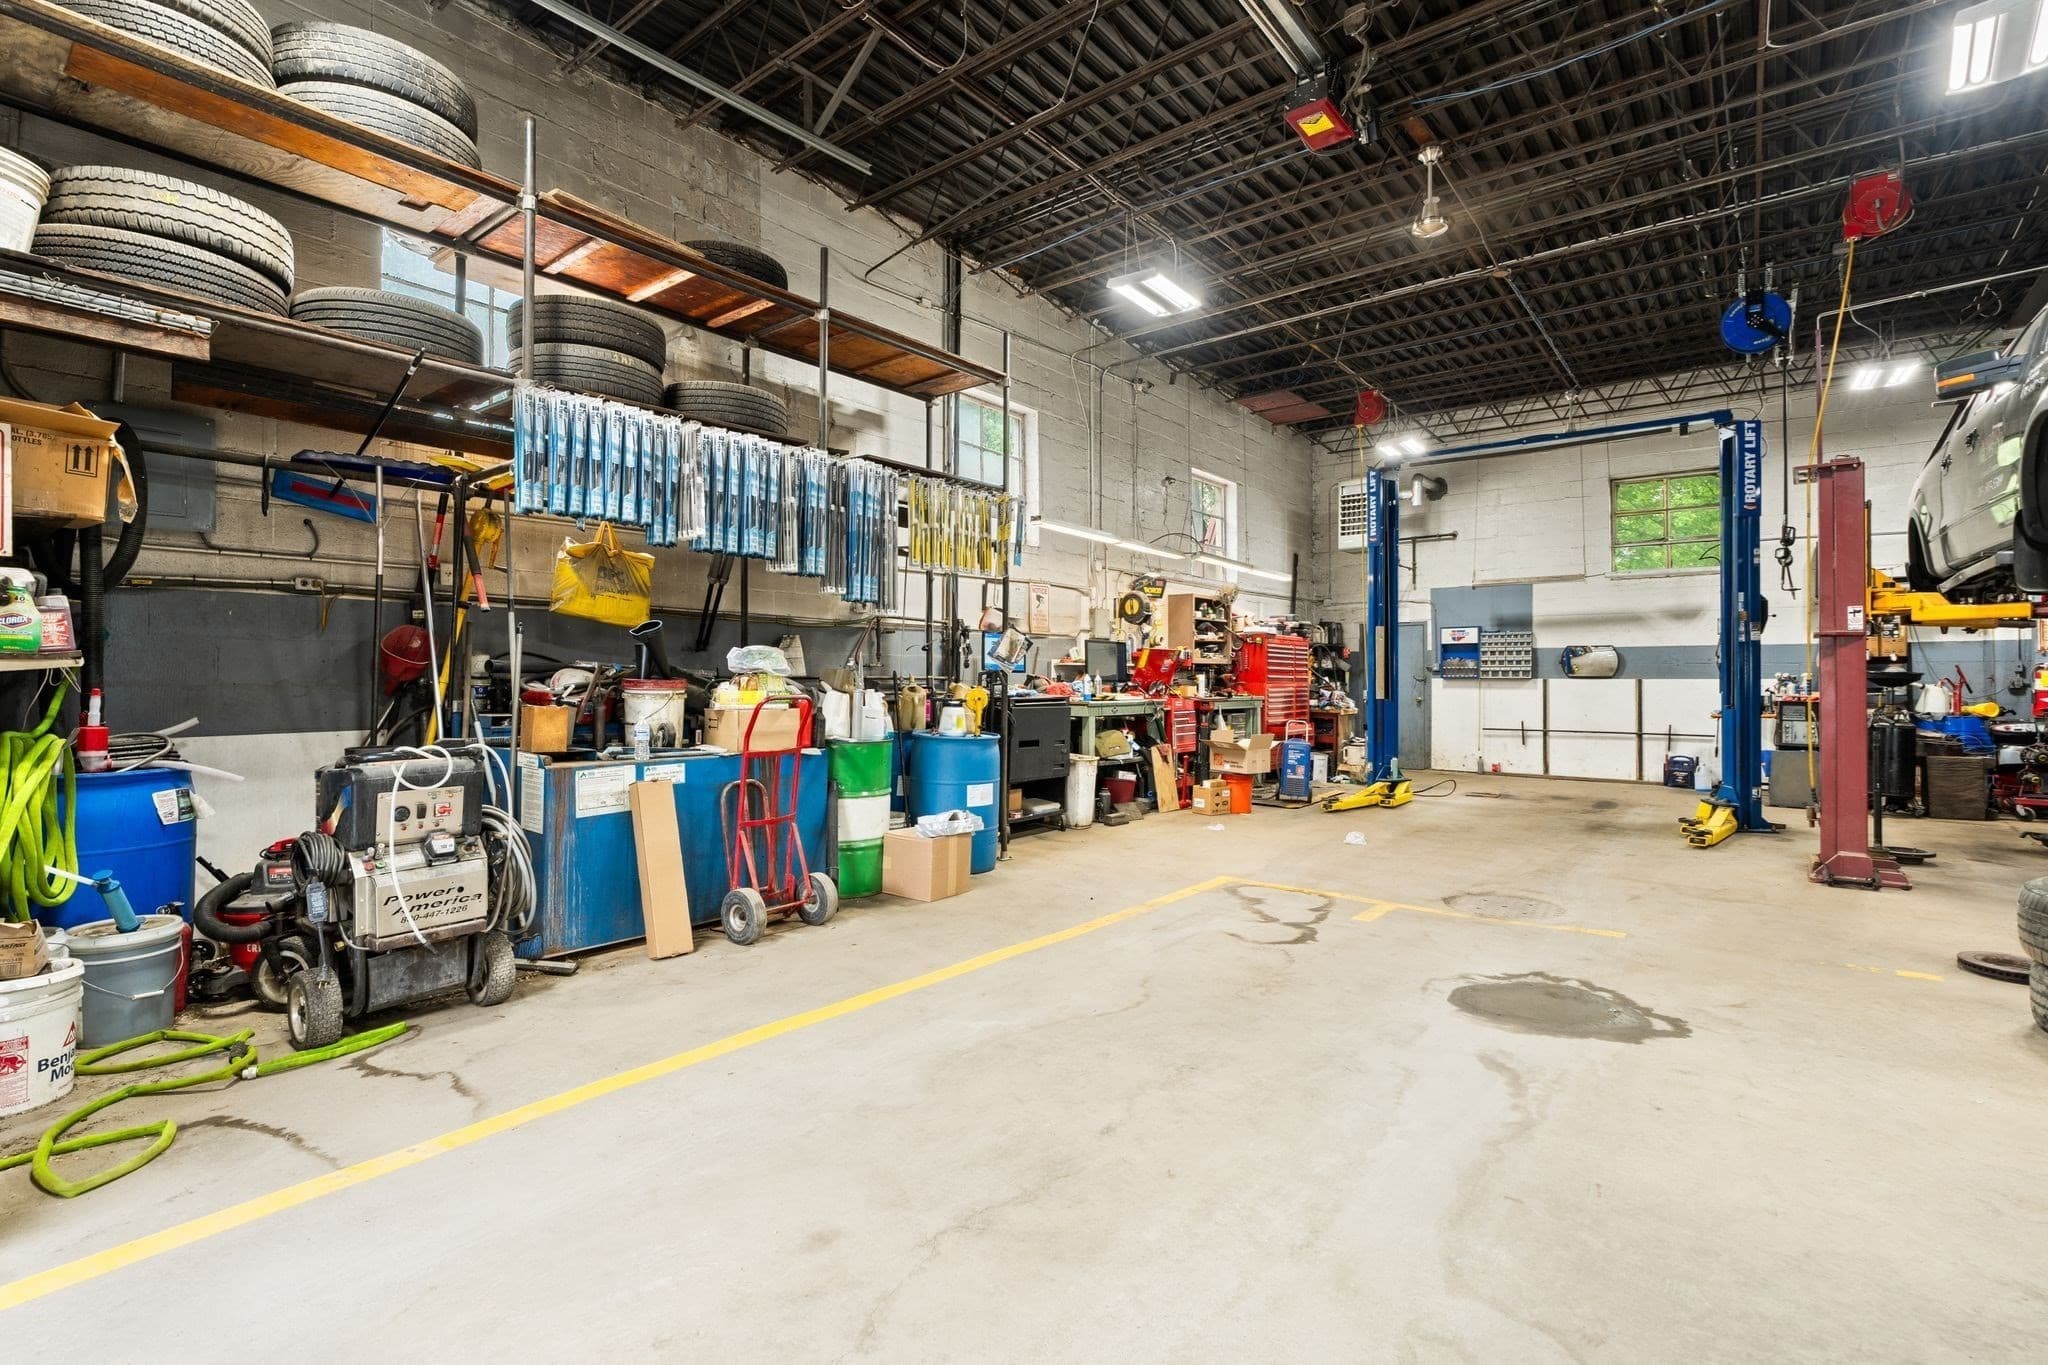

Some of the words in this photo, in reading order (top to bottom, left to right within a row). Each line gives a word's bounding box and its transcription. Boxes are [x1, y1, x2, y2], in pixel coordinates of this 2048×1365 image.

[1744, 422, 1756, 448] LIFT
[1369, 470, 1377, 492] LIFT
[1744, 452, 1756, 503] ROTARY
[1369, 495, 1377, 536] ROTARY
[383, 886, 455, 906] Power
